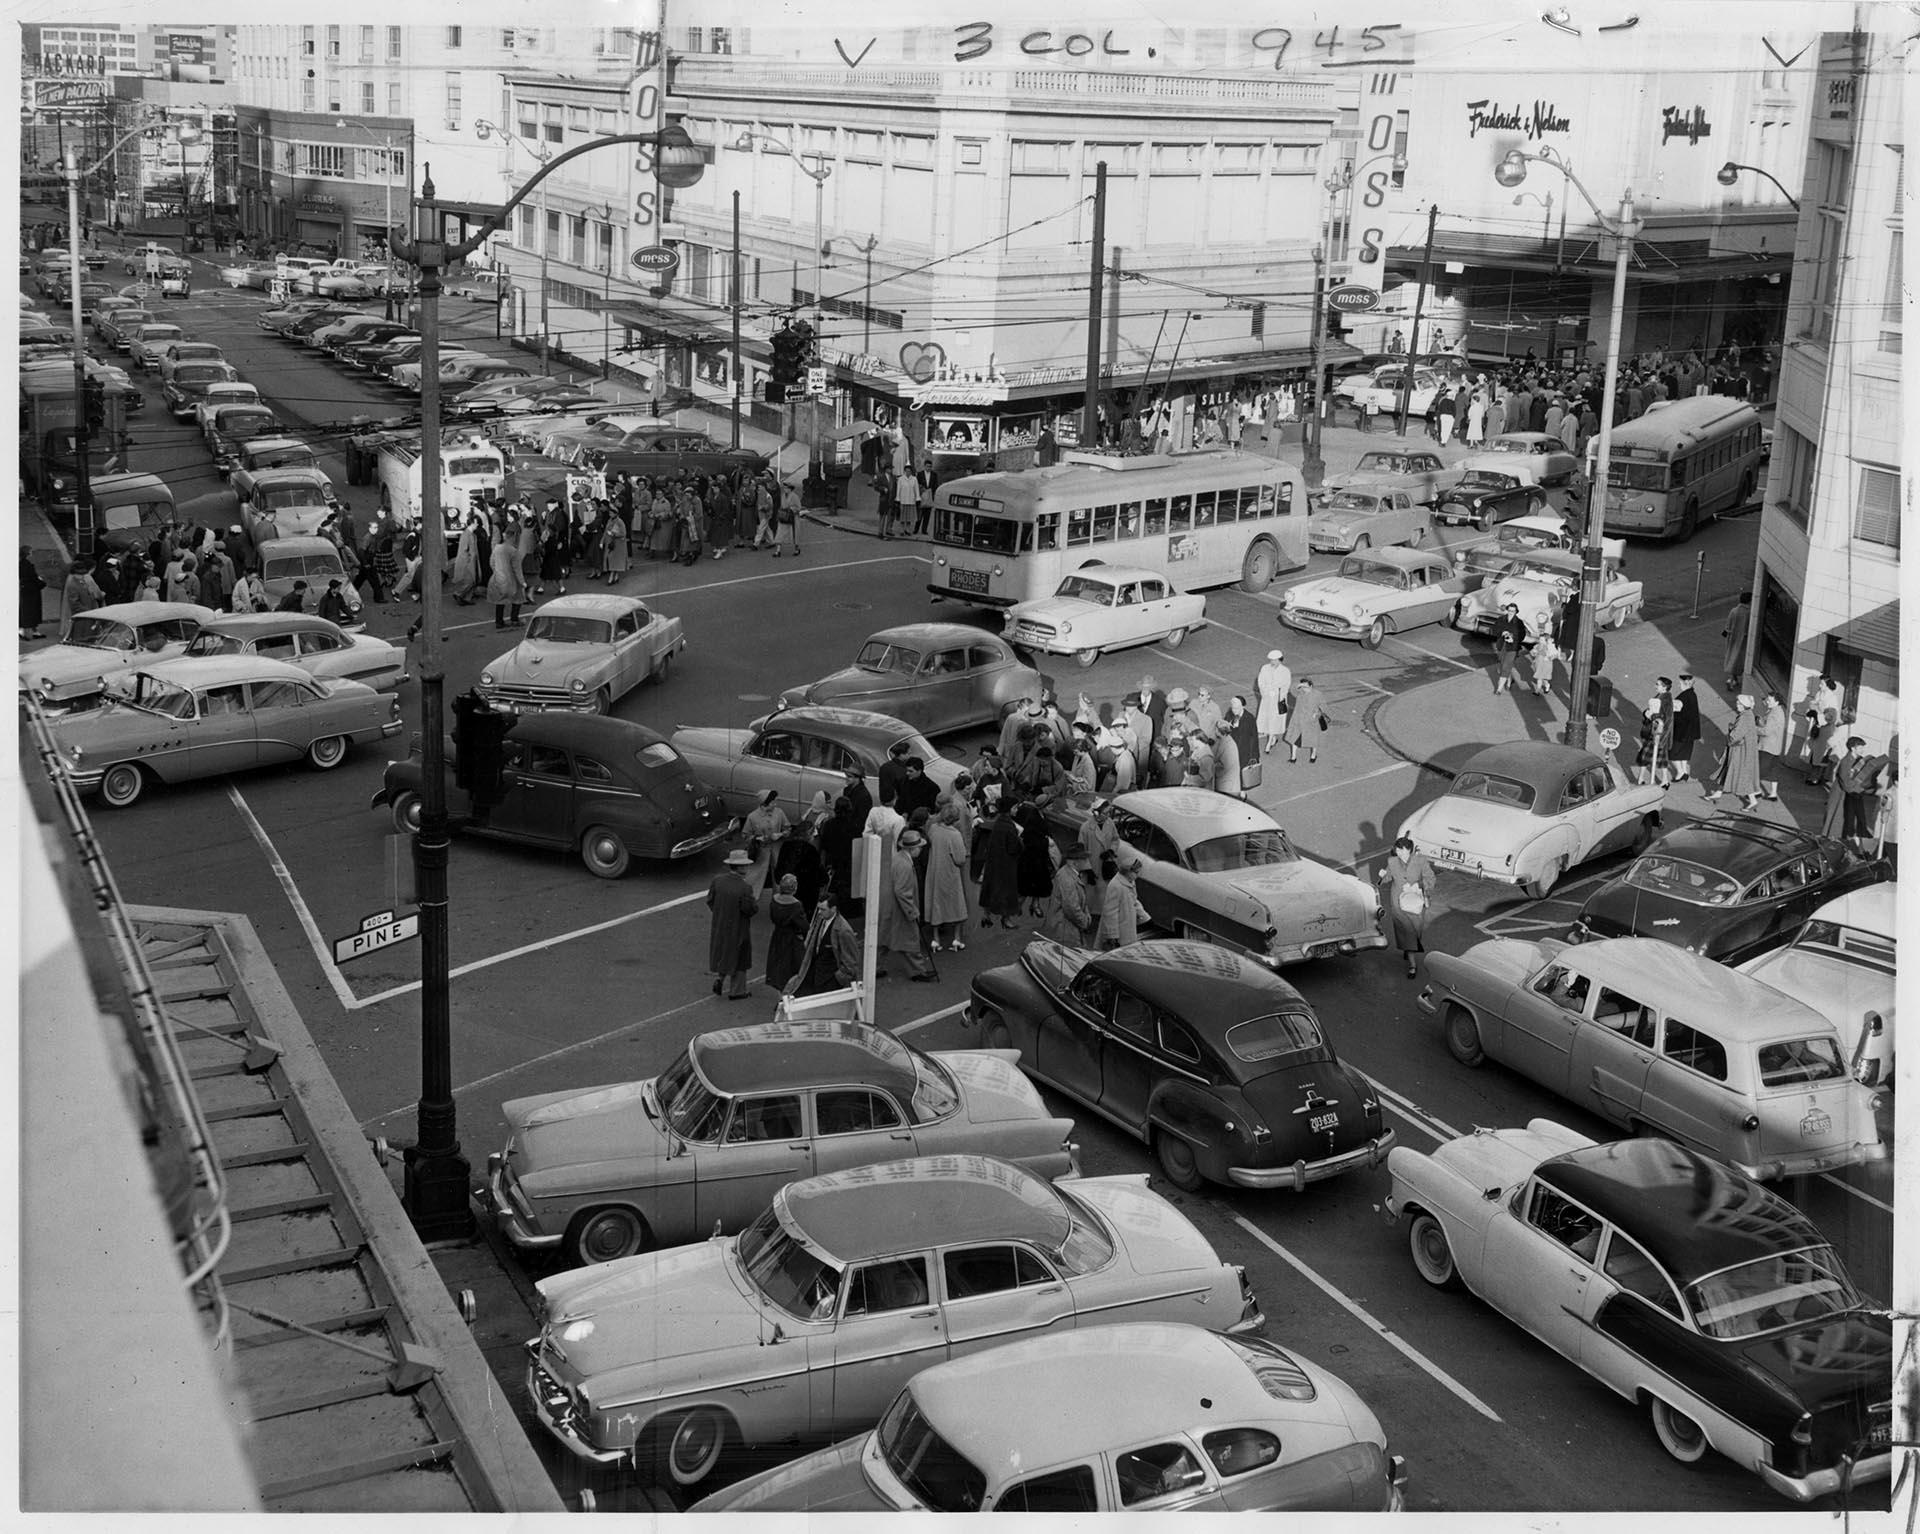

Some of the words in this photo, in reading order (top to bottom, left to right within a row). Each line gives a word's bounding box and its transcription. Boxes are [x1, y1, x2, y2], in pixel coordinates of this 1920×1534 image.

[33, 53, 105, 76] PACKARD
[1467, 99, 1521, 138] Frederick
[1529, 99, 1570, 141] Nelson
[1337, 293, 1370, 304] moss
[1202, 392, 1230, 405] SALE
[484, 424, 498, 437] 57
[951, 573, 987, 588] RHODES
[353, 924, 402, 952] PINE
